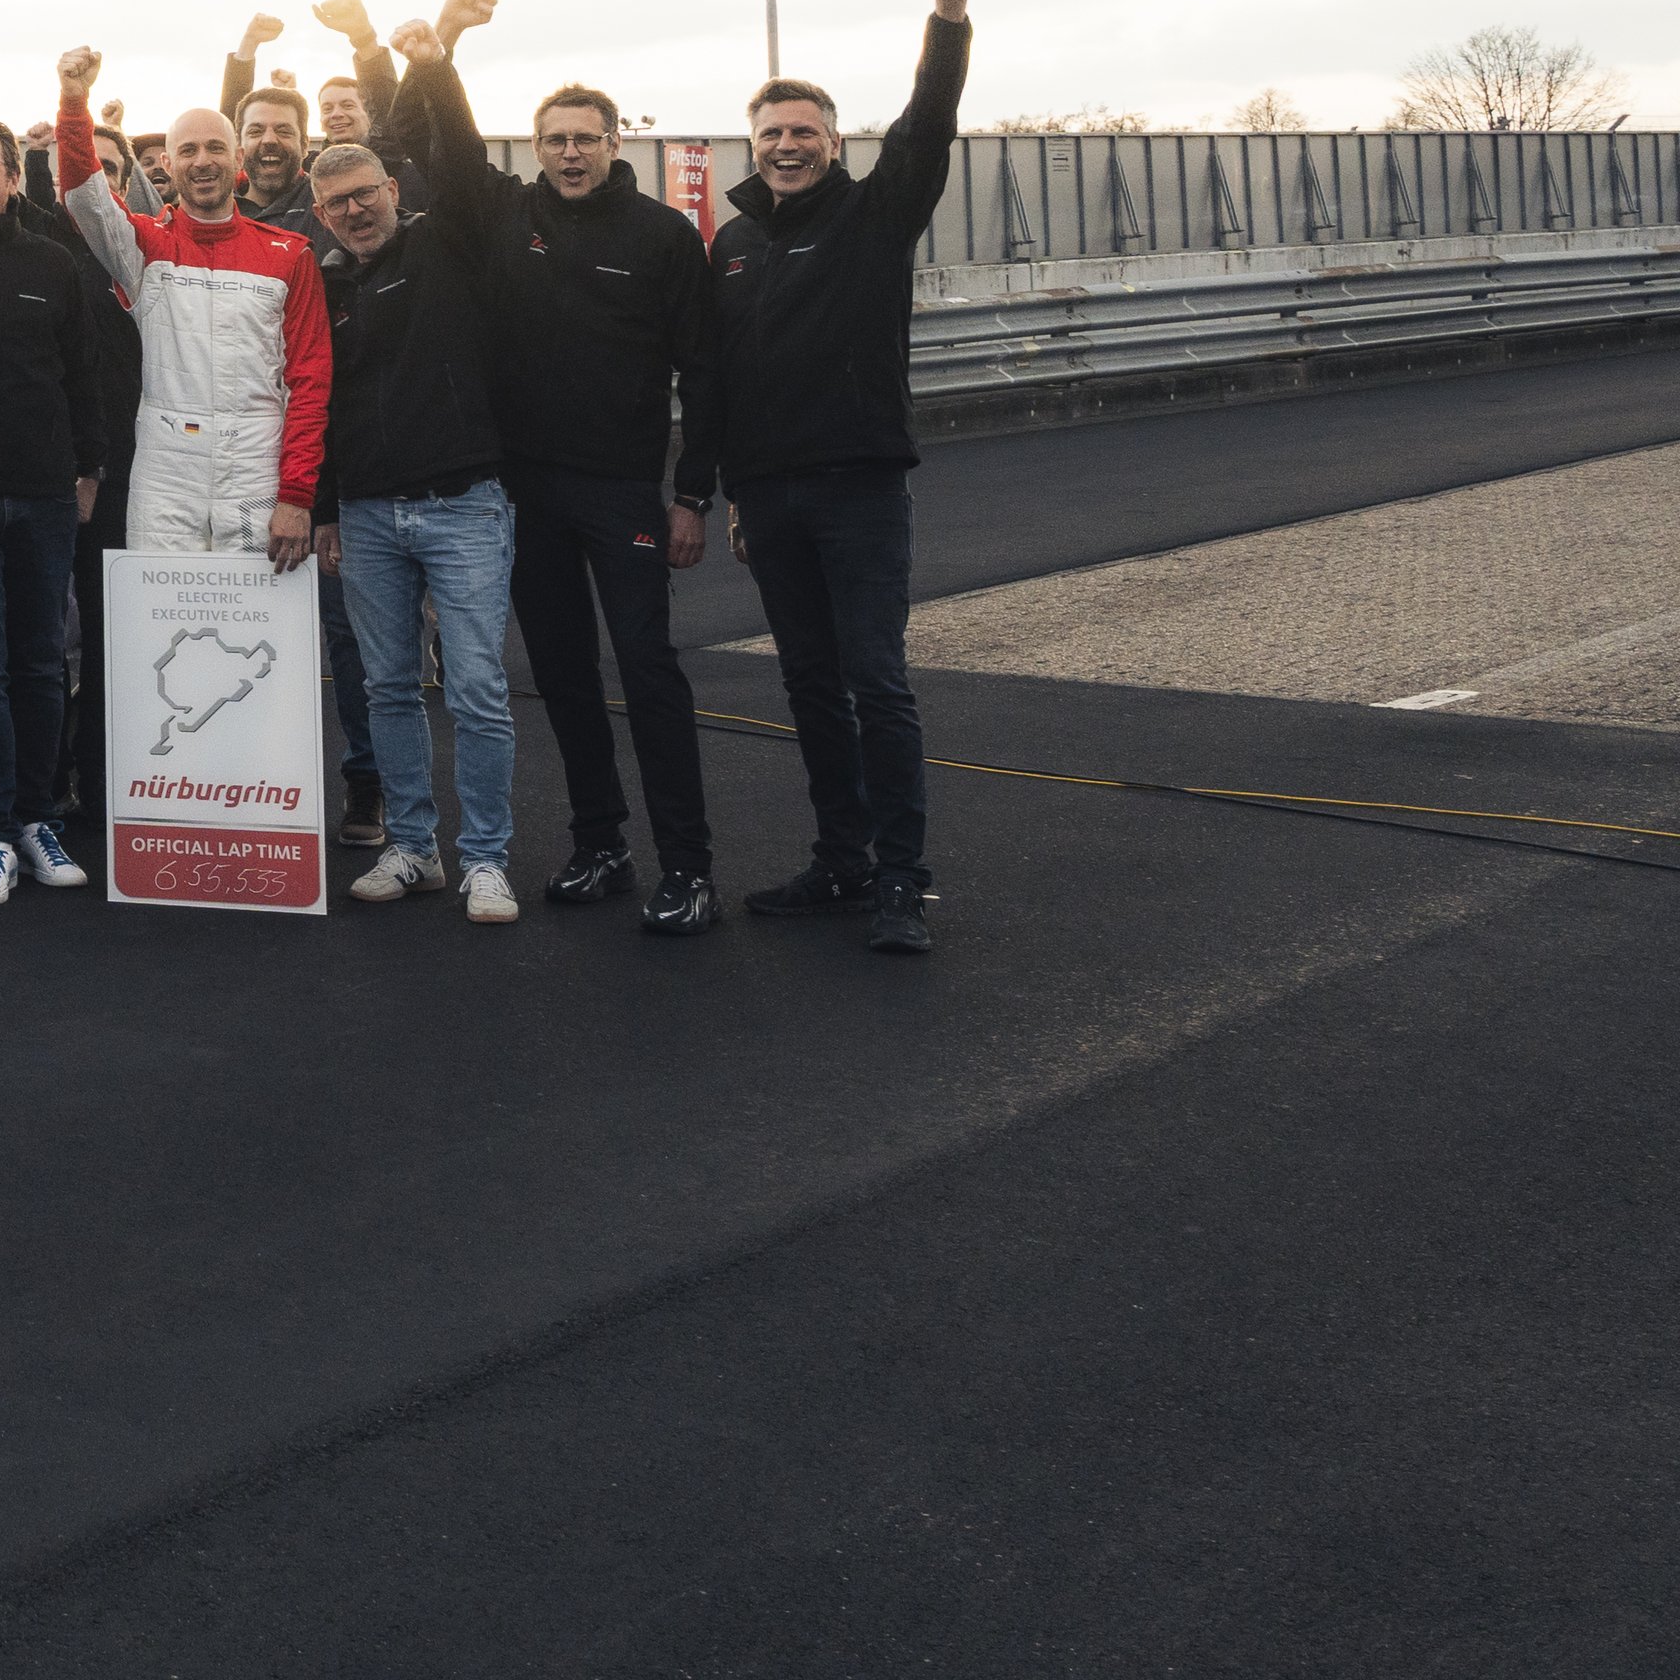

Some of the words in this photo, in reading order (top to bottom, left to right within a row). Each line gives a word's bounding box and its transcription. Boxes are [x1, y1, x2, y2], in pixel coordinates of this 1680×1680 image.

[669, 149, 709, 171] Pitstop
[677, 168, 703, 185] Area
[160, 272, 275, 297] PORSCHE
[142, 570, 279, 587] NORDSCHLEIFE
[177, 591, 243, 604] ELECTRIC
[152, 608, 229, 622] EXECUTIVE
[232, 610, 270, 623] CARS
[129, 775, 301, 811] nürburgring
[131, 837, 214, 856] OFFICIAL
[218, 842, 253, 858] LAP
[256, 844, 302, 861] TIME
